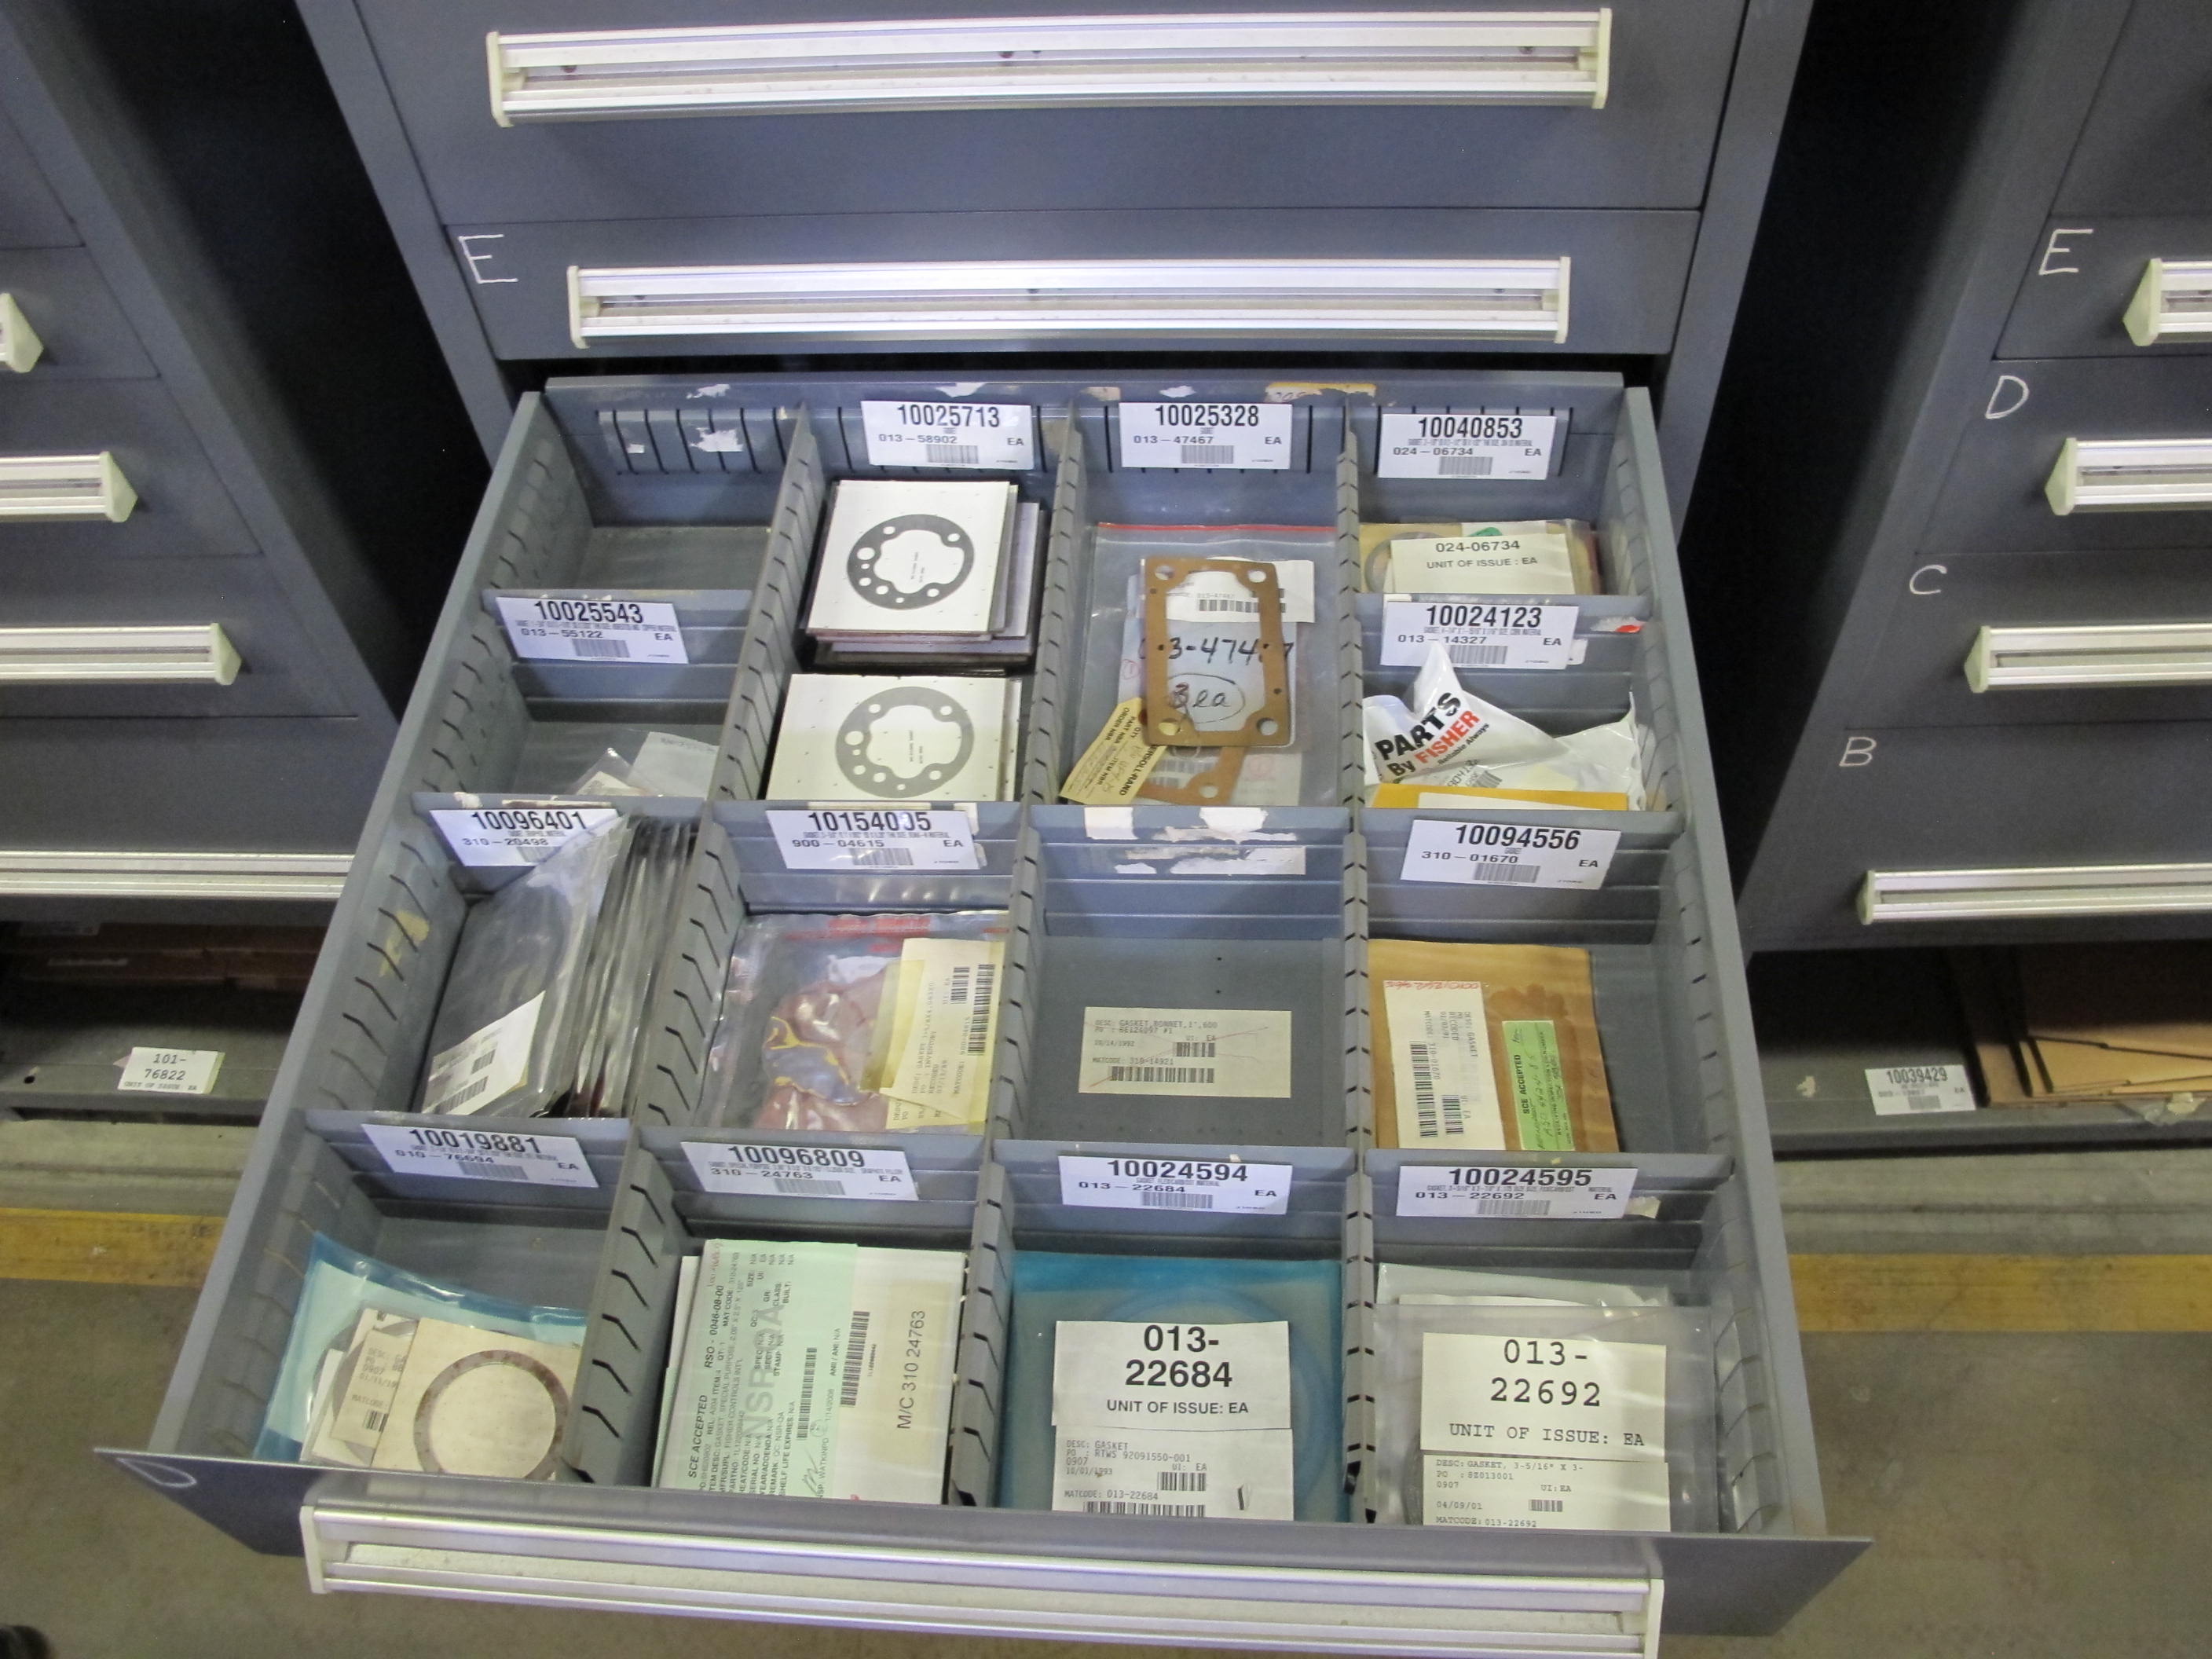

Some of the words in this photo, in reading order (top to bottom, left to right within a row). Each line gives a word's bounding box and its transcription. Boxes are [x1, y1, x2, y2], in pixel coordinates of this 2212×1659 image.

[458, 234, 518, 284] E
[2038, 229, 2093, 275] E
[1984, 375, 2030, 419] D
[897, 404, 1000, 427] 10025713
[1155, 405, 1259, 427] 10025328
[1418, 417, 1523, 438] 10040853
[1007, 438, 1024, 446] EA
[1265, 436, 1282, 445] EA
[1524, 449, 1541, 457] EA
[1436, 540, 1520, 553] 024-06734
[1426, 560, 1453, 569] UNIT
[1457, 559, 1472, 568] OF
[1910, 565, 1947, 595] C
[534, 600, 643, 623] 10025543
[1426, 605, 1542, 628] 10024123
[1374, 692, 1462, 760] PARTS
[1386, 760, 1417, 778] By
[1415, 710, 1481, 764] FISHER
[1839, 737, 1877, 767] B
[471, 811, 587, 830] 10096401
[943, 839, 964, 848] EA
[1456, 825, 1581, 850] 10094556
[1579, 859, 1599, 868] EA
[153, 1053, 186, 1064] 101-
[144, 1068, 186, 1081] 76822
[1514, 1055, 1527, 1094] ACCEPTED
[1886, 1067, 1948, 1085] 10039429
[1521, 1099, 1529, 1114] SCE
[409, 1129, 542, 1154] 10019881
[557, 1162, 579, 1170] EA
[728, 1146, 866, 1167] 10096809
[878, 1174, 902, 1183] EA
[1107, 1159, 1248, 1182] 10024594
[1449, 1168, 1592, 1187] 10024595
[906, 1310, 925, 1357] 24763
[1144, 1324, 1220, 1353] 013-
[704, 1346, 714, 1368] RSO
[1503, 1339, 1588, 1366] 013-
[902, 1363, 918, 1391] 310
[1125, 1359, 1233, 1388] 22684
[1490, 1377, 1601, 1408] 22692
[897, 1397, 914, 1429] M/C
[1107, 1400, 1142, 1412] UNIT
[1148, 1401, 1168, 1413] OF
[1174, 1402, 1224, 1414] ISSUE:
[1229, 1402, 1249, 1413] EA
[692, 1395, 707, 1453] ACCEPTED
[1448, 1423, 1495, 1438] UNIT
[1507, 1426, 1530, 1440] OF
[1542, 1428, 1610, 1445] ISSUE:
[1623, 1433, 1646, 1447] EA
[1095, 1441, 1129, 1452] GASKET
[688, 1456, 699, 1478] SCE
[1196, 1463, 1207, 1471] EA
[1106, 1490, 1159, 1501] 013-22684
